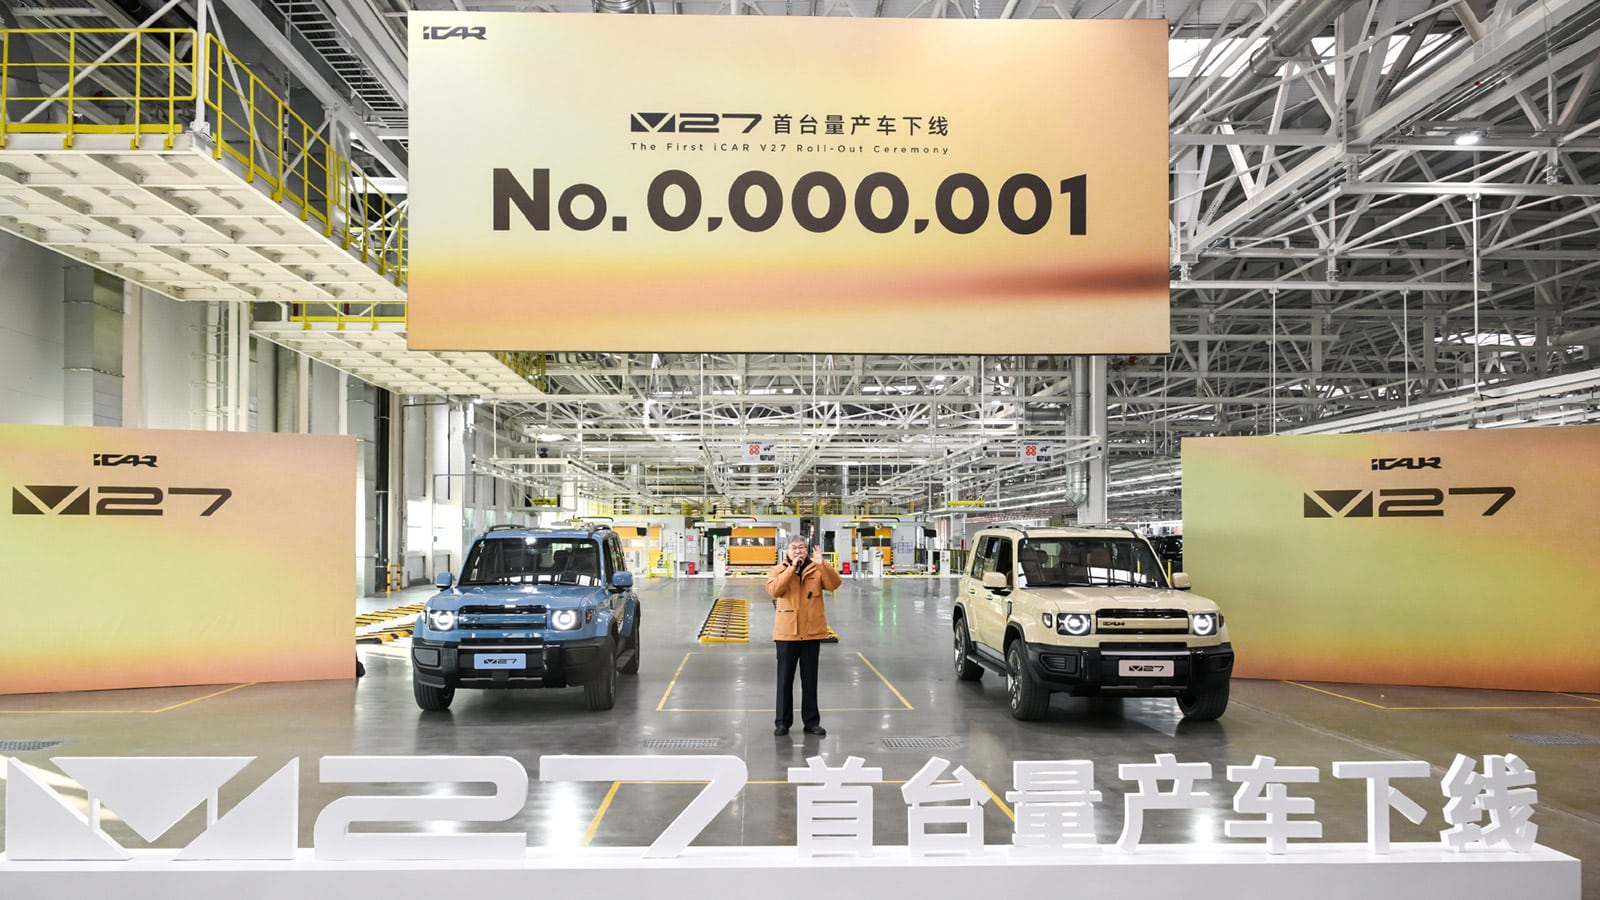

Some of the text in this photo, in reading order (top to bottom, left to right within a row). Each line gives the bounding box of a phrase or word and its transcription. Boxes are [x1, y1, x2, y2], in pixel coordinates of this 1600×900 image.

[773, 113, 949, 137] 首台量产车下线
[630, 142, 949, 155] The First iCAR V27 Roll-Out Ceremony
[493, 168, 1087, 236] No. 0,000,001
[787, 753, 1539, 858] 首台量产车下线
